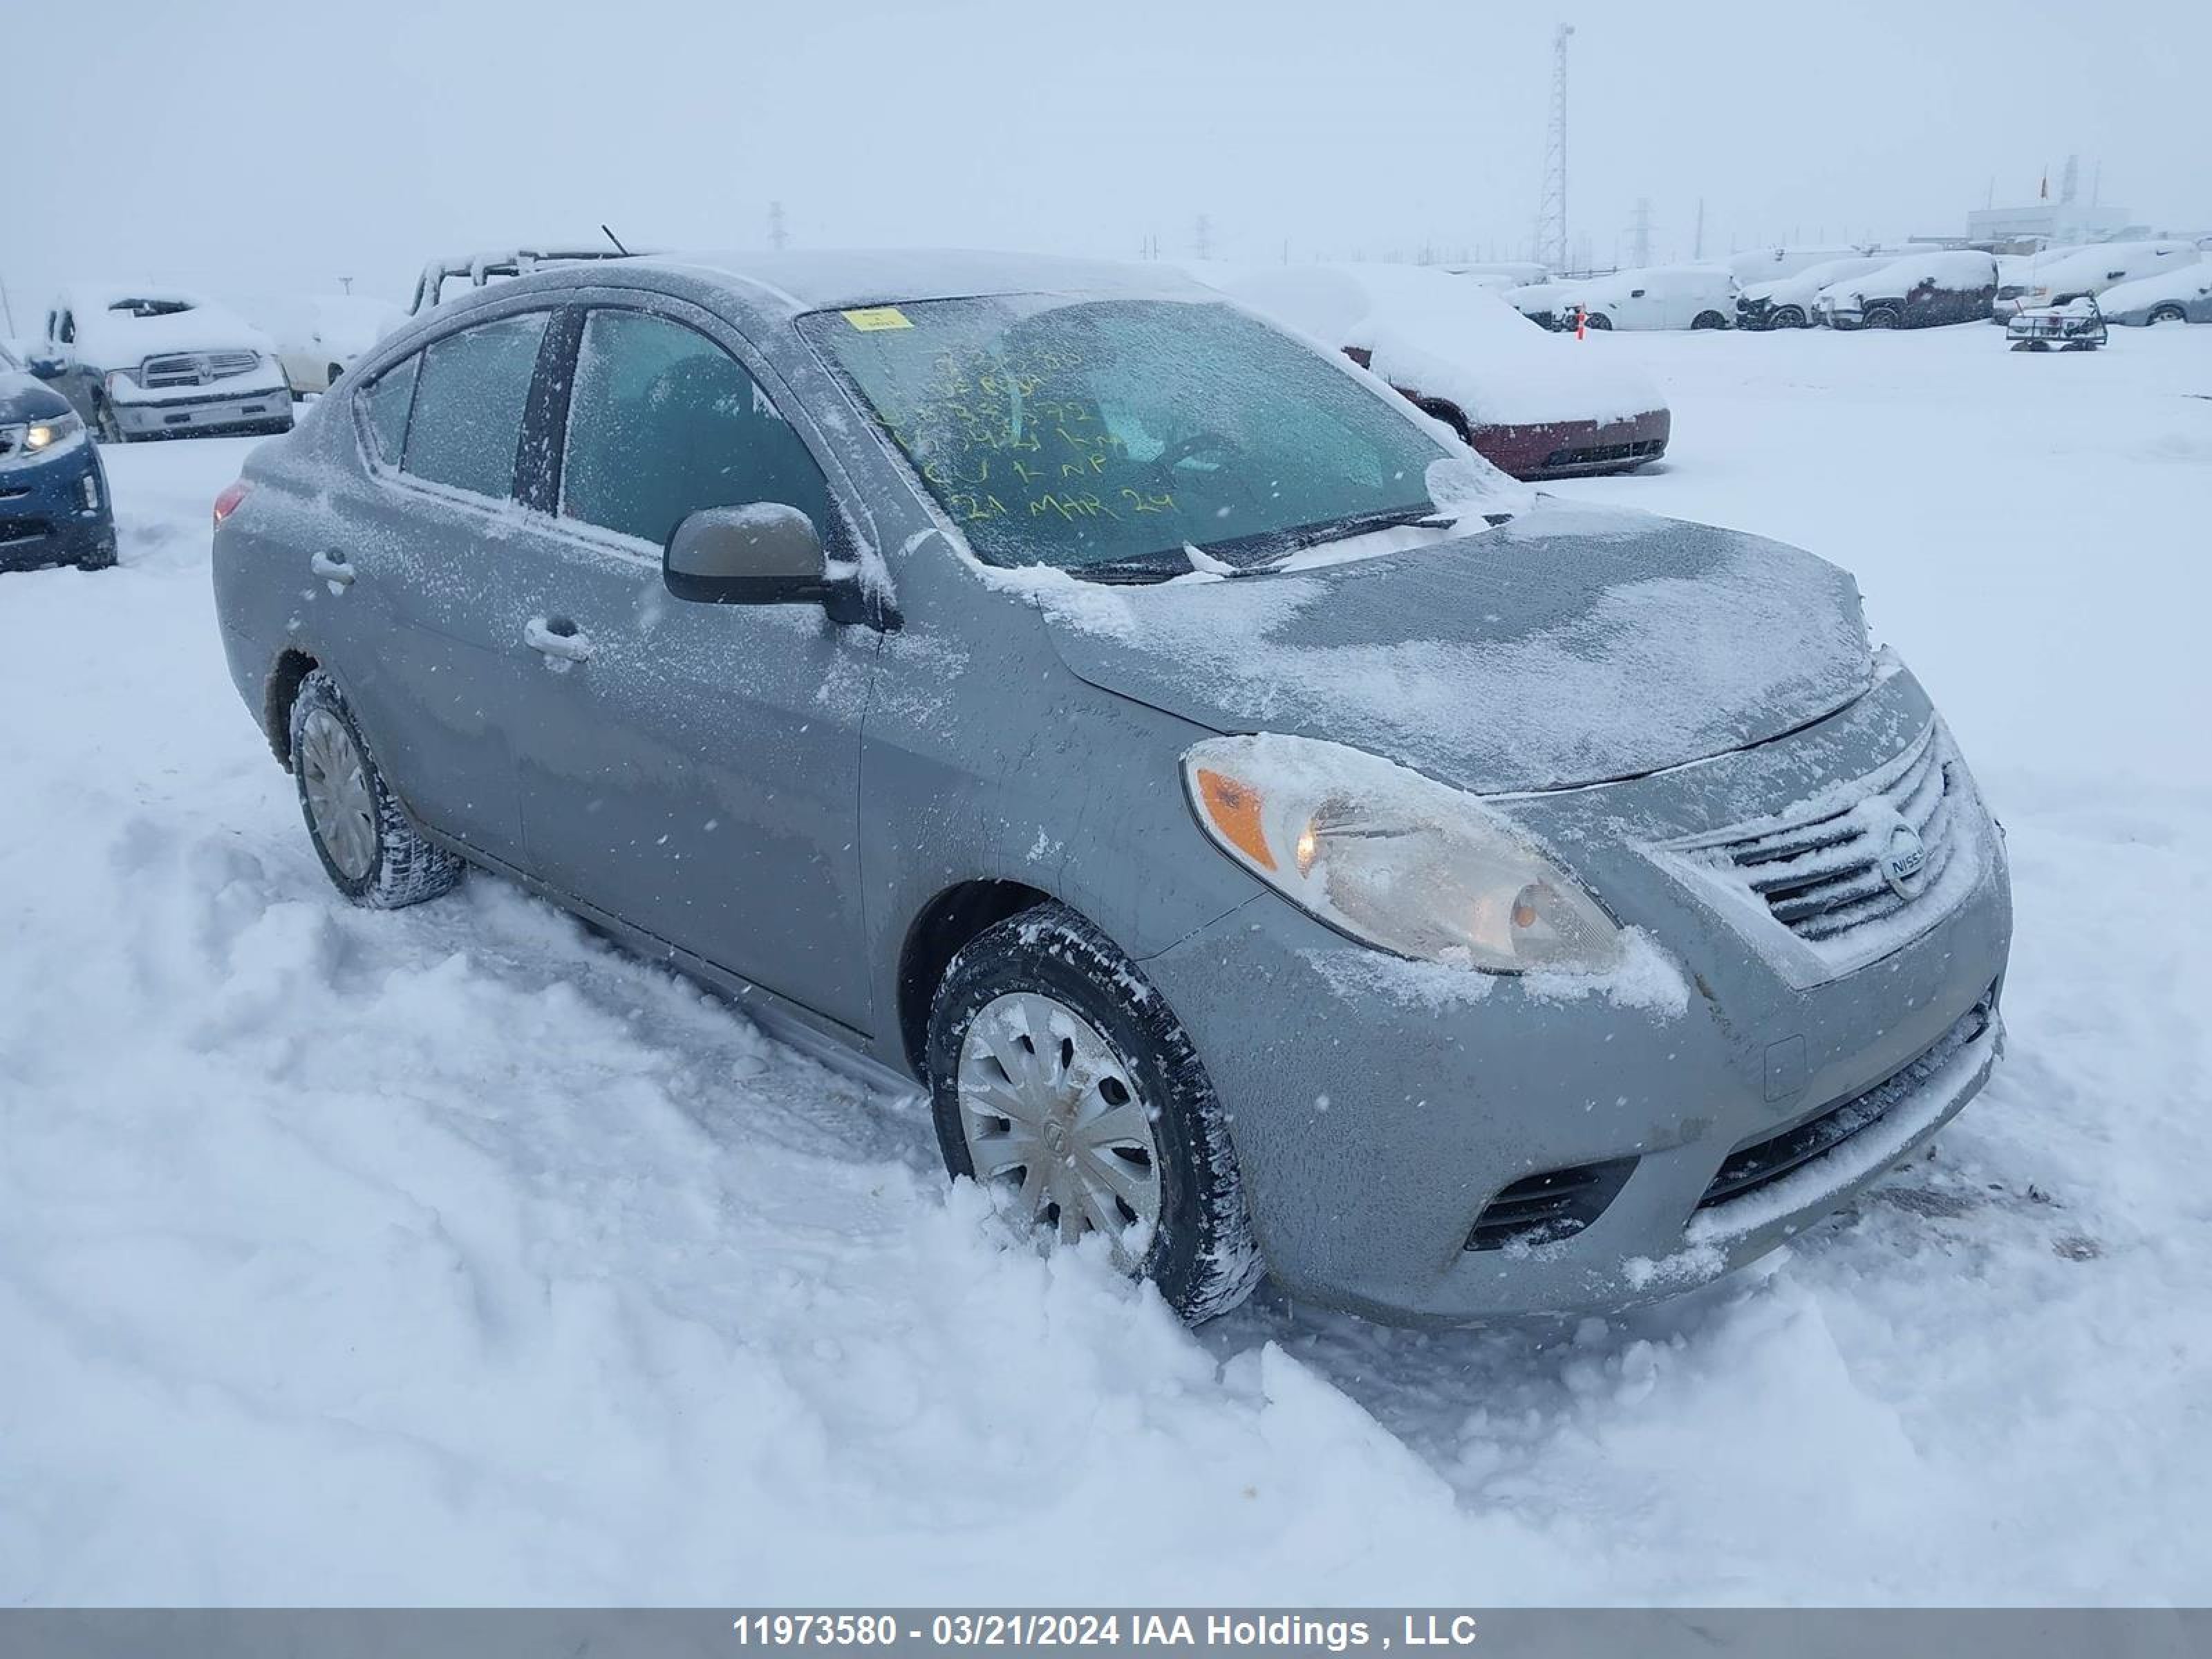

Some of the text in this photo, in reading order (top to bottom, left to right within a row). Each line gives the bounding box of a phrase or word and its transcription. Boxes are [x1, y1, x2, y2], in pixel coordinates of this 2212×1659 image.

[950, 489, 1181, 521] 21 MAR 24
